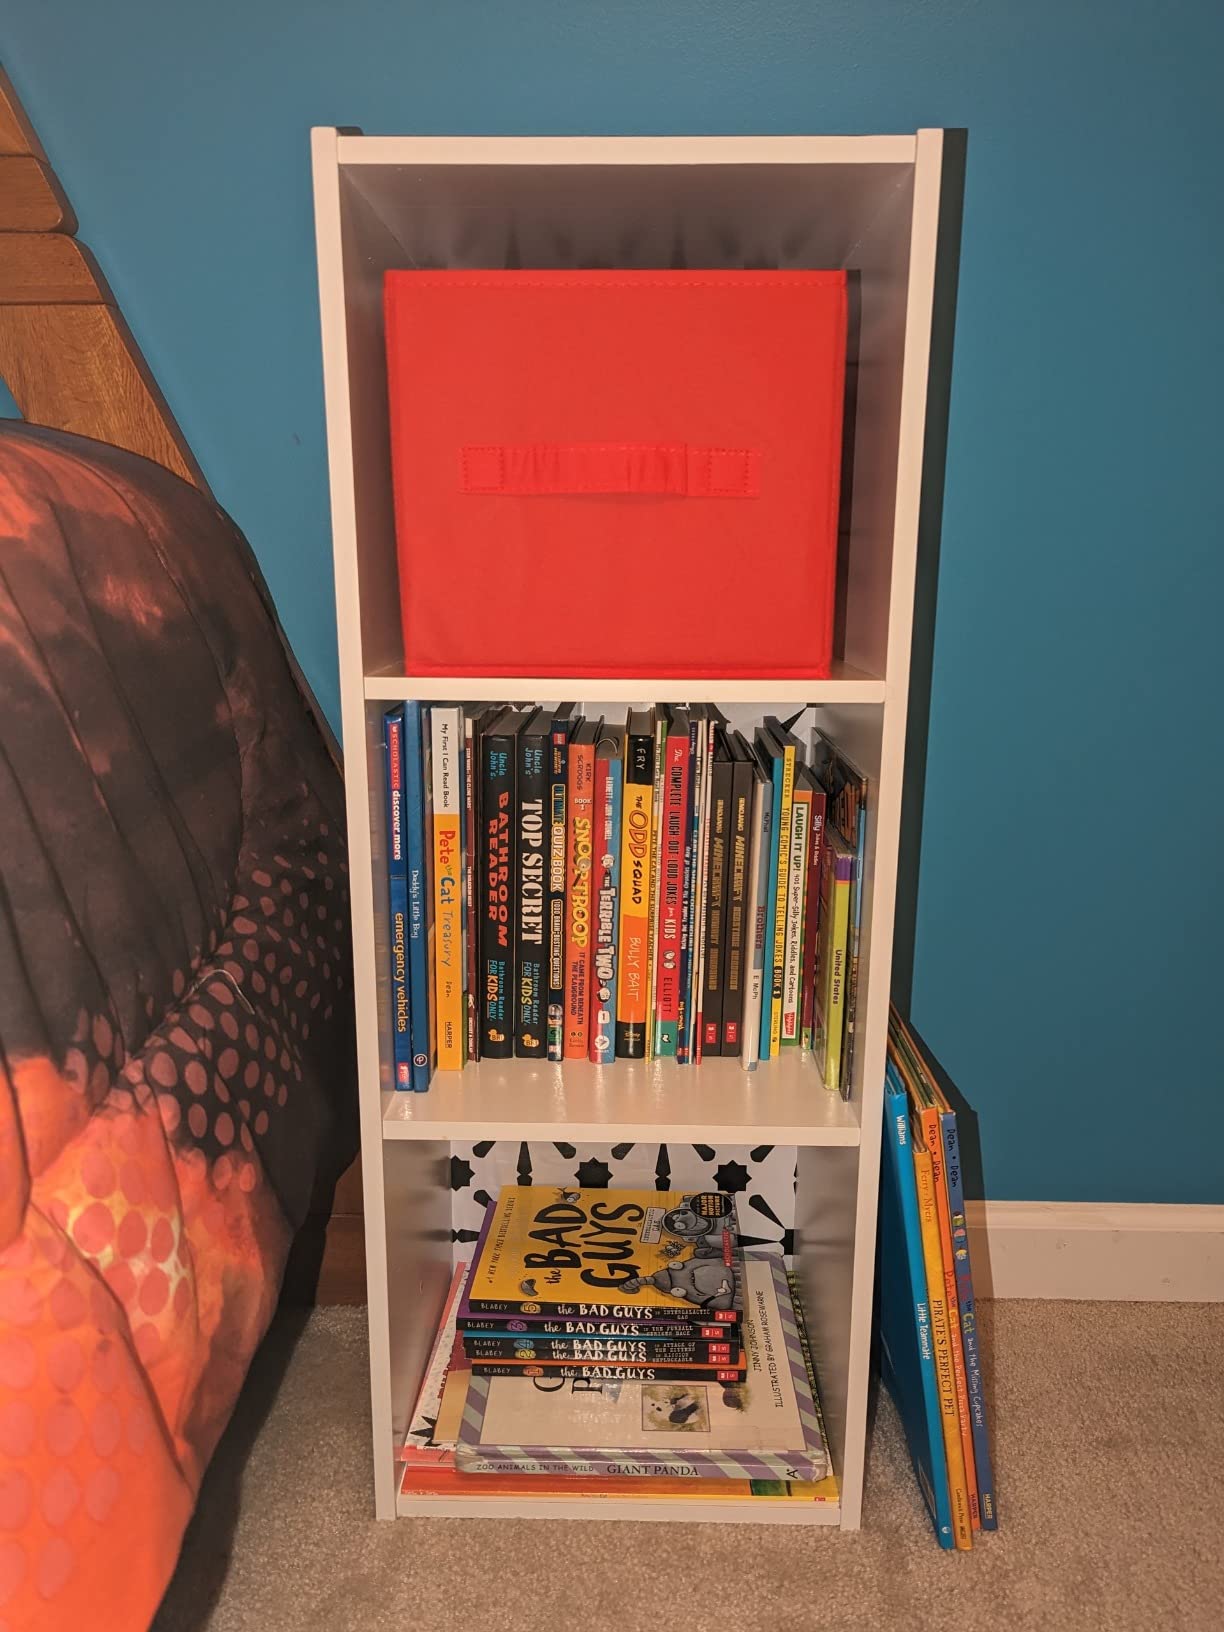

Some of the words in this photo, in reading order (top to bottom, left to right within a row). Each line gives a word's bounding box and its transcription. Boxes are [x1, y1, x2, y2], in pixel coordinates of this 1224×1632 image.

[440, 723, 448, 734] My
[498, 752, 508, 776] Uncle
[534, 749, 542, 774] Uncle
[635, 748, 646, 770] FRY
[670, 766, 682, 806] COMPLETE
[392, 790, 401, 832] discover
[522, 799, 542, 848] TOP
[782, 808, 790, 831] YOUNG
[794, 806, 804, 840] LAUGH
[813, 815, 822, 831] Silly
[439, 830, 456, 864] Pete
[552, 827, 565, 858] QUIZ
[628, 810, 648, 858] ODD
[794, 843, 802, 852] IT
[780, 833, 788, 865] COMIC'S
[488, 819, 498, 920] READER
[498, 792, 509, 947] BATHROOM
[551, 860, 564, 891] BOOK
[793, 855, 802, 871] UP!
[410, 870, 419, 898] Daddy's
[440, 876, 456, 904] Cat
[632, 860, 642, 904] SQUAD
[778, 868, 787, 888] GUIDE
[522, 852, 544, 944] SECRET
[666, 882, 678, 905] JOKES
[778, 894, 786, 902] TO
[790, 886, 800, 919] Super-Silly
[572, 882, 589, 948] TROOP
[598, 888, 616, 943] TERRIBLE
[755, 906, 765, 950] Brothers
[776, 906, 784, 936] TELLING
[410, 923, 420, 938] Boy
[441, 911, 454, 966] Treasury
[664, 919, 676, 940] KIDS
[393, 912, 405, 982] emergency
[626, 937, 641, 969] BULLY
[775, 940, 784, 963] JOKES
[489, 960, 498, 974] FOR
[523, 962, 532, 976] FOR
[595, 945, 615, 979] TWO
[834, 949, 842, 977] United
[488, 975, 498, 1001] KIDS
[521, 978, 533, 1005] KIDS
[628, 972, 640, 1002] BAIT
[663, 977, 672, 1013] ELLIOTT
[788, 977, 796, 1004] Cartoons
[832, 979, 841, 1005] States
[396, 985, 408, 1033] vehicles
[895, 1114, 906, 1145] Williams
[929, 1124, 937, 1147] Dean
[947, 1129, 956, 1152] Dean
[934, 1161, 942, 1183] Dean
[950, 1165, 959, 1188] Dean
[524, 1204, 588, 1268] BAD
[580, 1202, 645, 1288] GUYS
[544, 1268, 562, 1285] the
[557, 1304, 575, 1315] the
[579, 1304, 609, 1317] BAD
[613, 1306, 653, 1320] GUYS
[756, 1290, 768, 1327] ROSEWARNE
[916, 1303, 926, 1322] Little
[544, 1321, 562, 1333] the
[565, 1322, 595, 1334] BAD
[600, 1323, 639, 1336] GUYS
[748, 1320, 758, 1350] JOHNSON
[932, 1300, 947, 1346] PIRATE'S
[963, 1312, 974, 1334] Cat
[551, 1339, 569, 1349] the
[572, 1340, 604, 1350] BAD
[606, 1340, 646, 1352] GUYS
[763, 1328, 774, 1353] GRAHAM
[919, 1324, 930, 1360] Teammate
[949, 1309, 957, 1329] Cat
[954, 1364, 964, 1392] Perfect
[552, 1350, 570, 1360] the
[574, 1350, 604, 1360] BAD
[607, 1350, 647, 1362] GUYS
[752, 1352, 762, 1372] JINNY
[766, 1354, 775, 1362] BY
[969, 1353, 977, 1367] the
[560, 1367, 578, 1377] the
[582, 1367, 614, 1378] BAD
[616, 1367, 655, 1379] GUYS
[766, 1362, 783, 1408] ILLUSTRATED
[938, 1349, 952, 1394] PERFECT
[943, 1395, 955, 1417] PET
[972, 1394, 983, 1427] Cupcakes
[607, 1464, 650, 1475] GIANT
[653, 1465, 698, 1476] PANDA
[984, 1493, 992, 1519] HARPER
